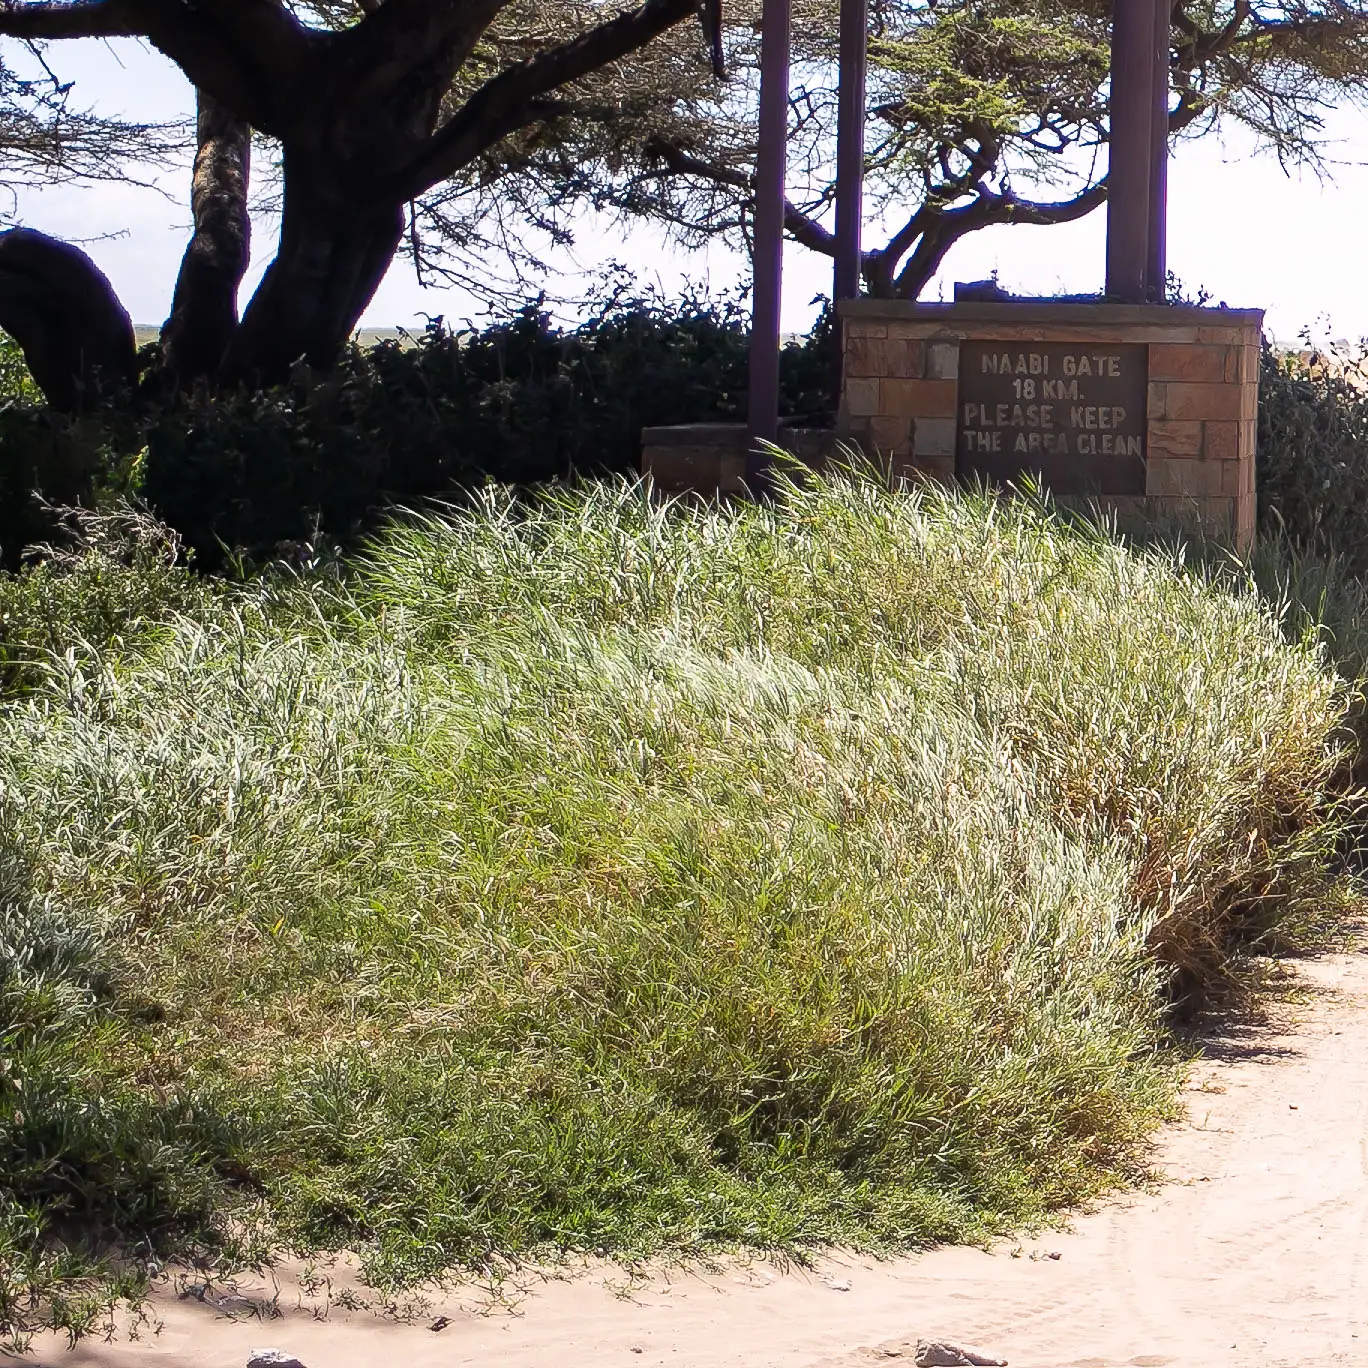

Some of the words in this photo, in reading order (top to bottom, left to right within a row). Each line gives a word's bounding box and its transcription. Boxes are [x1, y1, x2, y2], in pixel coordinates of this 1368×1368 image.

[1063, 355, 1121, 377] GATE
[1013, 378, 1036, 399] 18
[1043, 380, 1084, 400] KM.
[964, 402, 1054, 429] PLEASE
[1070, 406, 1127, 429] KEEP
[964, 430, 1002, 452] THE
[1014, 432, 1068, 454] AREA
[1077, 434, 1142, 456] CLEAN
